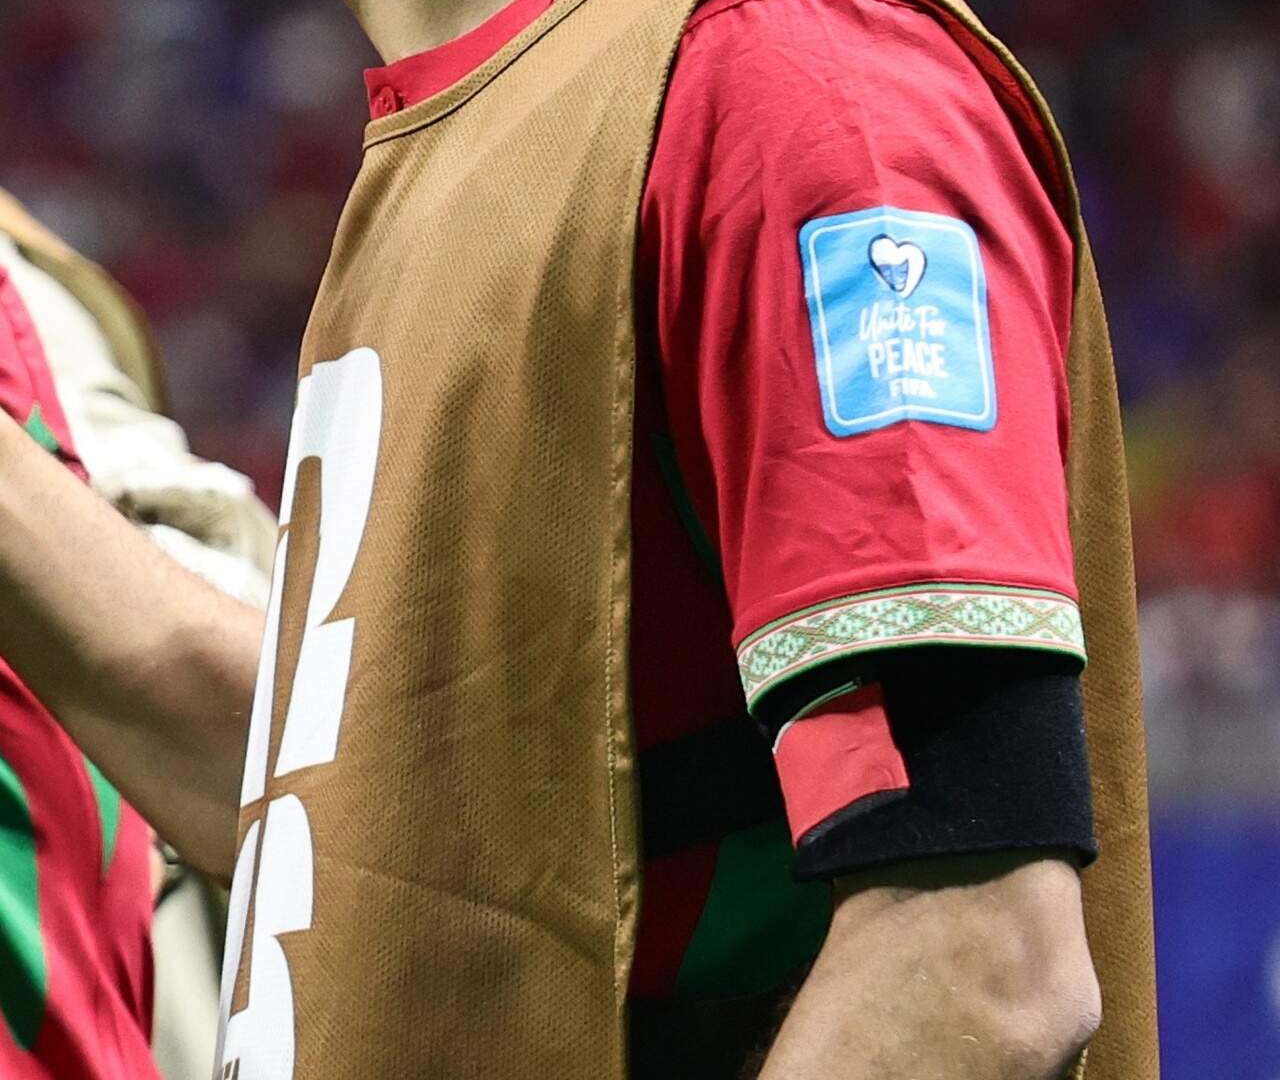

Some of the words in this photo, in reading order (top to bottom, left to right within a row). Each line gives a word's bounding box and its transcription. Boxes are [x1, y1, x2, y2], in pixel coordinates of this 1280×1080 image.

[859, 301, 916, 341] Unite
[914, 304, 947, 340] For
[867, 337, 950, 378] PEACE
[889, 377, 938, 398] FIFA
